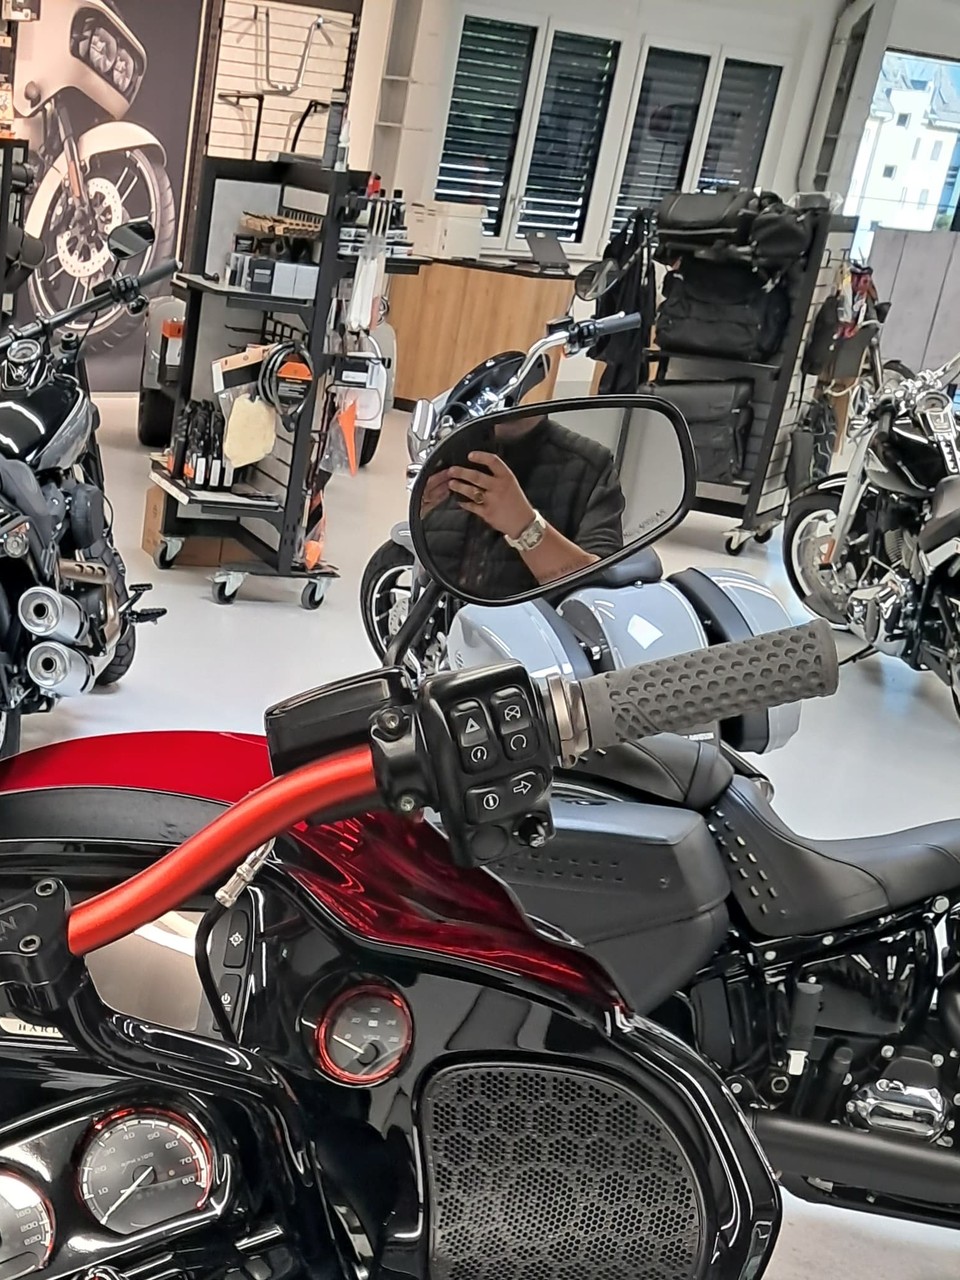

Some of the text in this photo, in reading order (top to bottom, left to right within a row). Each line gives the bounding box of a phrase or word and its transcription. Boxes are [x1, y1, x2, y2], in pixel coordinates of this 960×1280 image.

[123, 1131, 136, 1140] 40
[147, 1131, 161, 1140] 50
[165, 1140, 179, 1150] 60
[180, 1156, 193, 1166] 70
[181, 1176, 196, 1186] 80
[97, 1186, 109, 1196] 10
